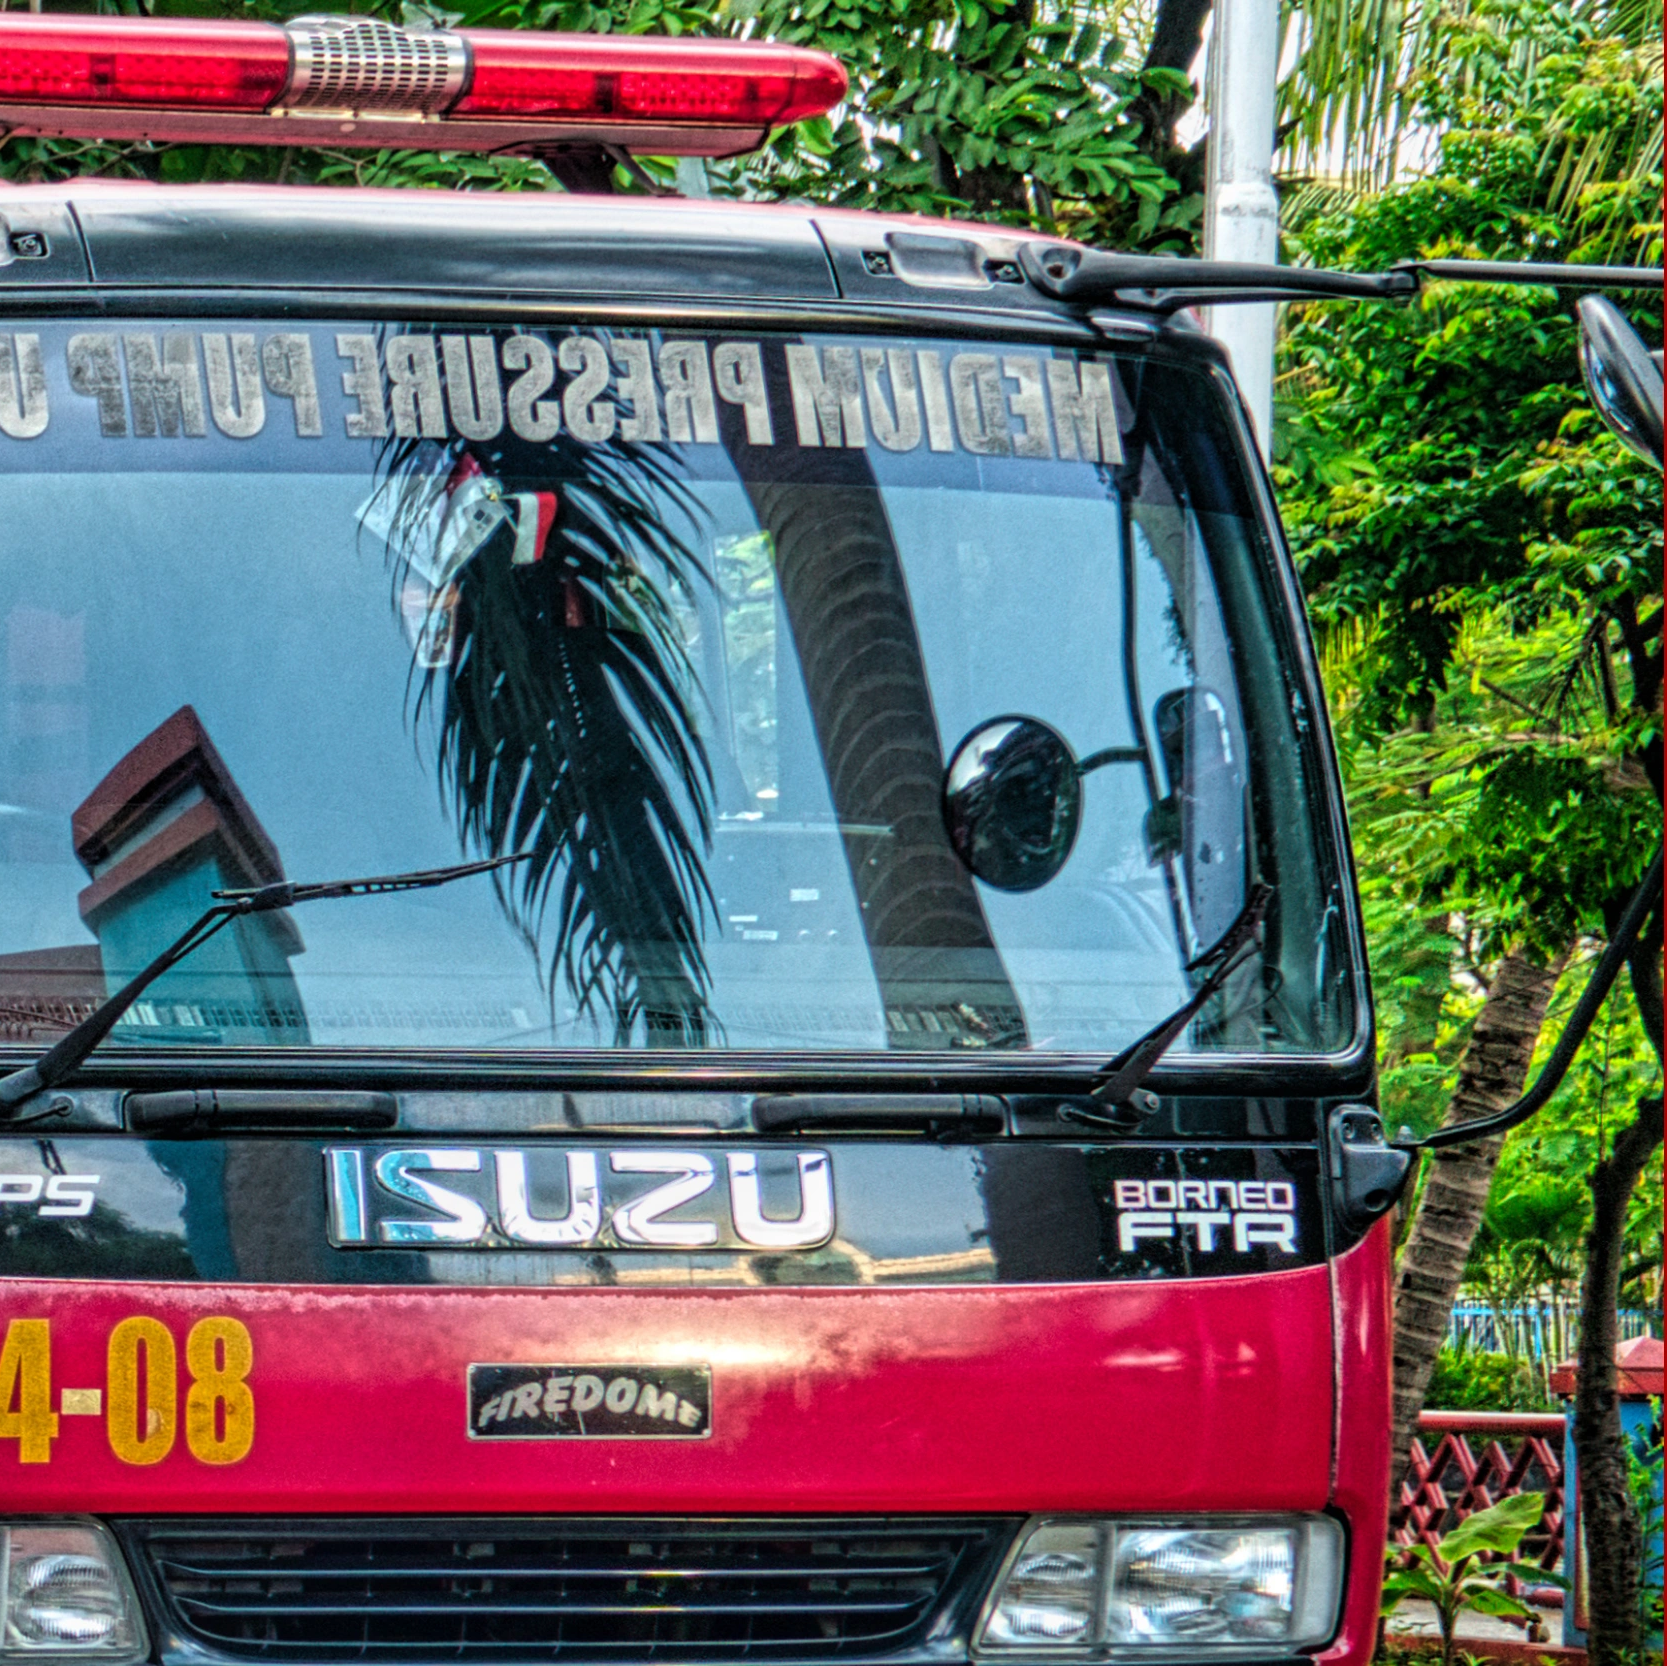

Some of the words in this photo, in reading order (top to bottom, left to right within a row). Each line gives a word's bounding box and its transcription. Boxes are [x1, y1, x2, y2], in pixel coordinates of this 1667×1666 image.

[325, 1146, 835, 1250] ISUZU
[1113, 1179, 1296, 1210] BORNEO
[1118, 1211, 1297, 1253] FTR
[478, 1374, 702, 1428] FIREDOME
